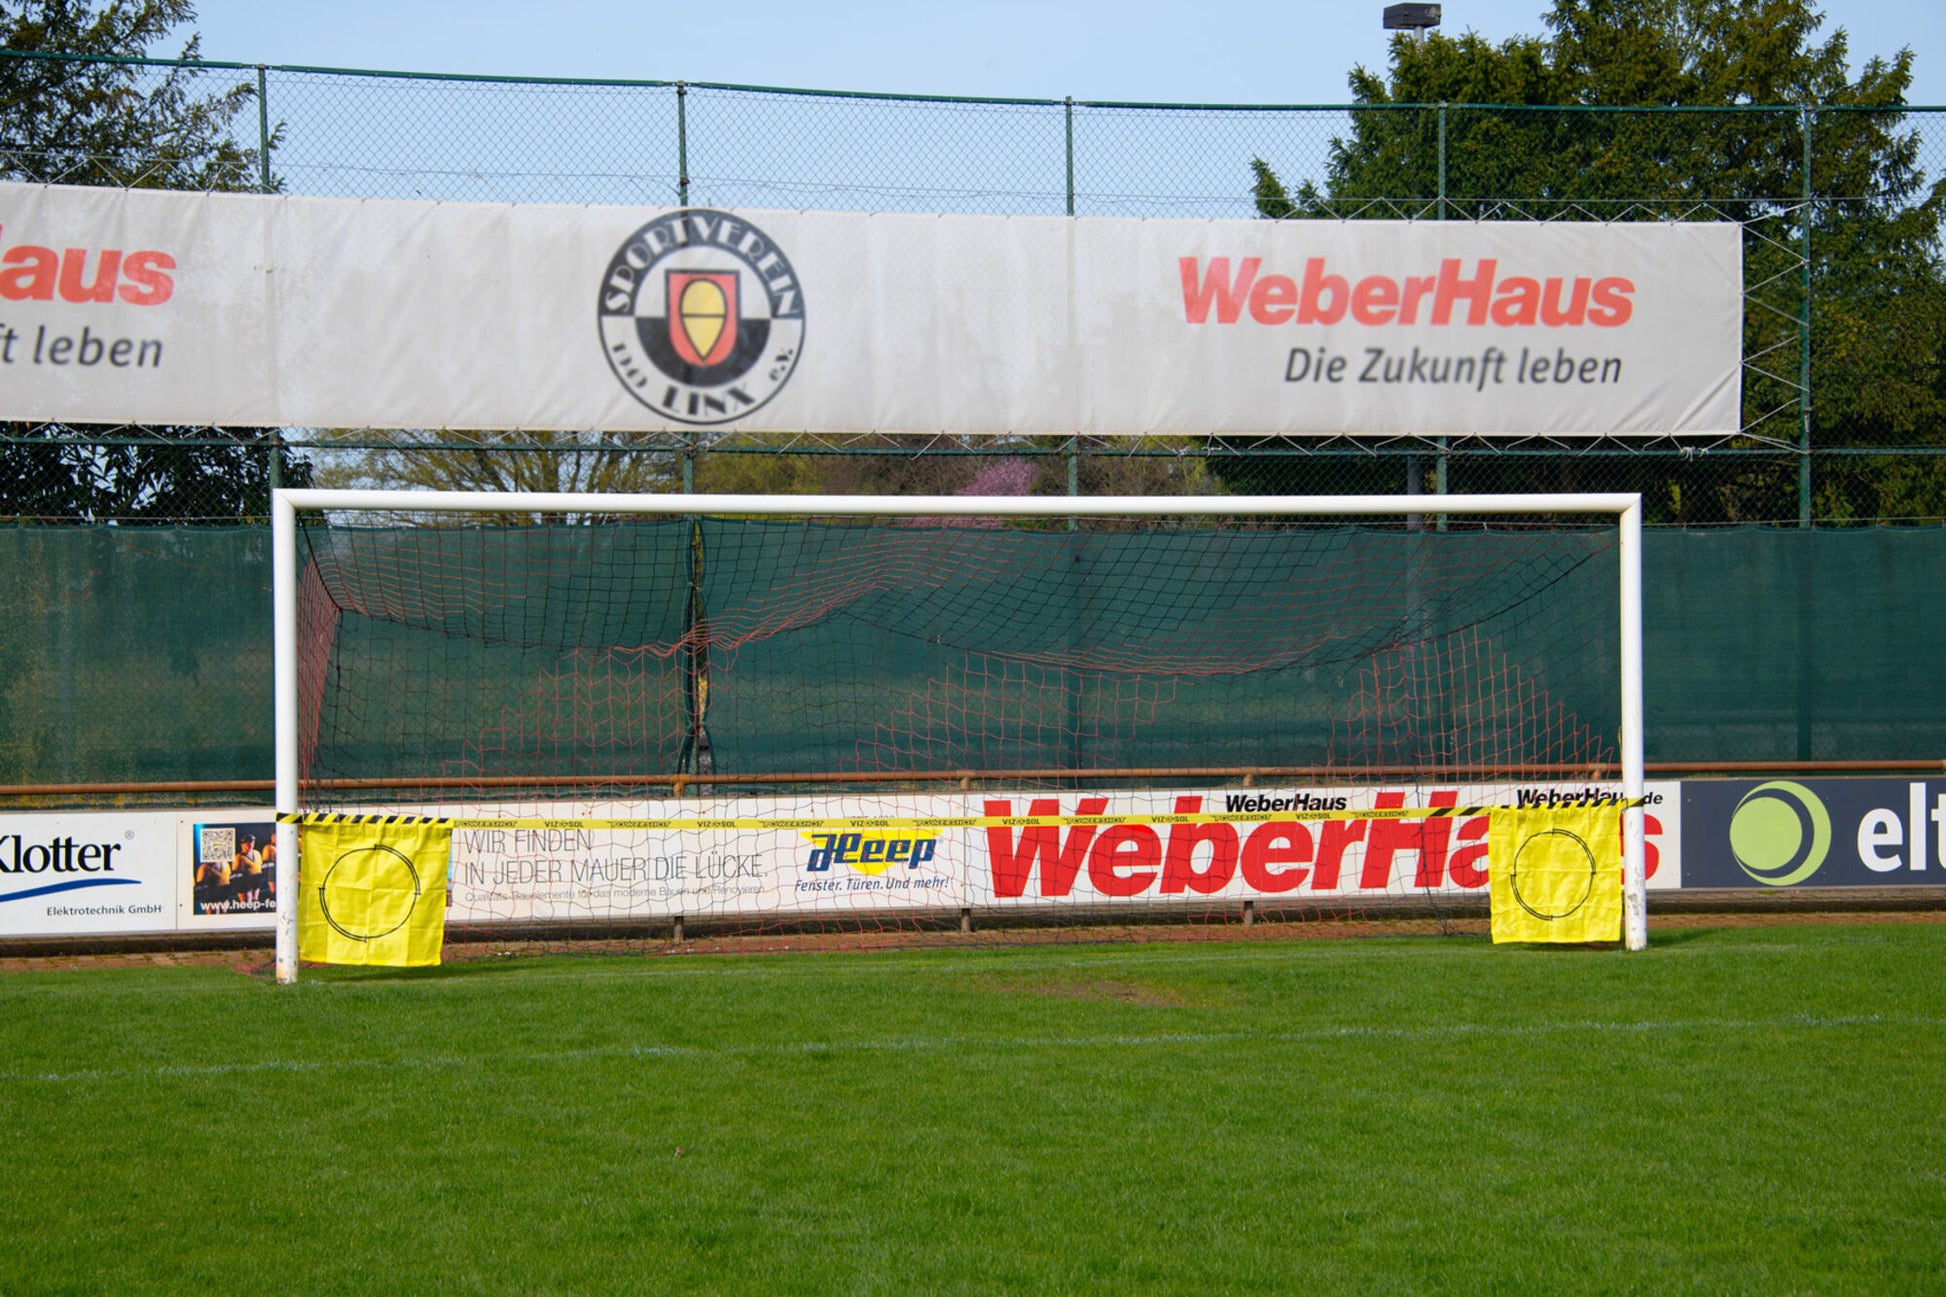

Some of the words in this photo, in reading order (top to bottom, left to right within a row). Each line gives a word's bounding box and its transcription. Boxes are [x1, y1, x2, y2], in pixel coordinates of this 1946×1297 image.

[0, 242, 178, 307] aus
[604, 215, 800, 318] SPORTVEREIN
[1178, 256, 1635, 328] WeberHaus
[32, 324, 163, 369] leben
[1285, 345, 1346, 383] Die
[1358, 347, 1506, 393] Zukunft
[1516, 350, 1622, 385] leben
[662, 384, 756, 418] LINX
[1226, 793, 1347, 813] WeberHaus
[0, 834, 122, 874] lotter
[464, 830, 506, 854] WIR
[515, 828, 592, 852] FINDEN
[807, 833, 937, 872] Heep
[464, 861, 485, 885] IN
[493, 860, 562, 884] JEDER
[571, 857, 647, 882] MAUER
[655, 856, 688, 880] DIE
[695, 850, 769, 879] LÜCKE.
[794, 879, 842, 892] Fenster.
[845, 877, 883, 890] Türen.
[885, 876, 909, 890] Und
[913, 876, 949, 889] mehr!
[593, 888, 611, 897] das
[613, 887, 656, 897] moderne
[659, 885, 689, 895] Bauen
[692, 885, 710, 895] und
[713, 884, 765, 894] Renovieren
[47, 904, 126, 917] Elektrotechnik
[128, 904, 162, 914] GmbH
